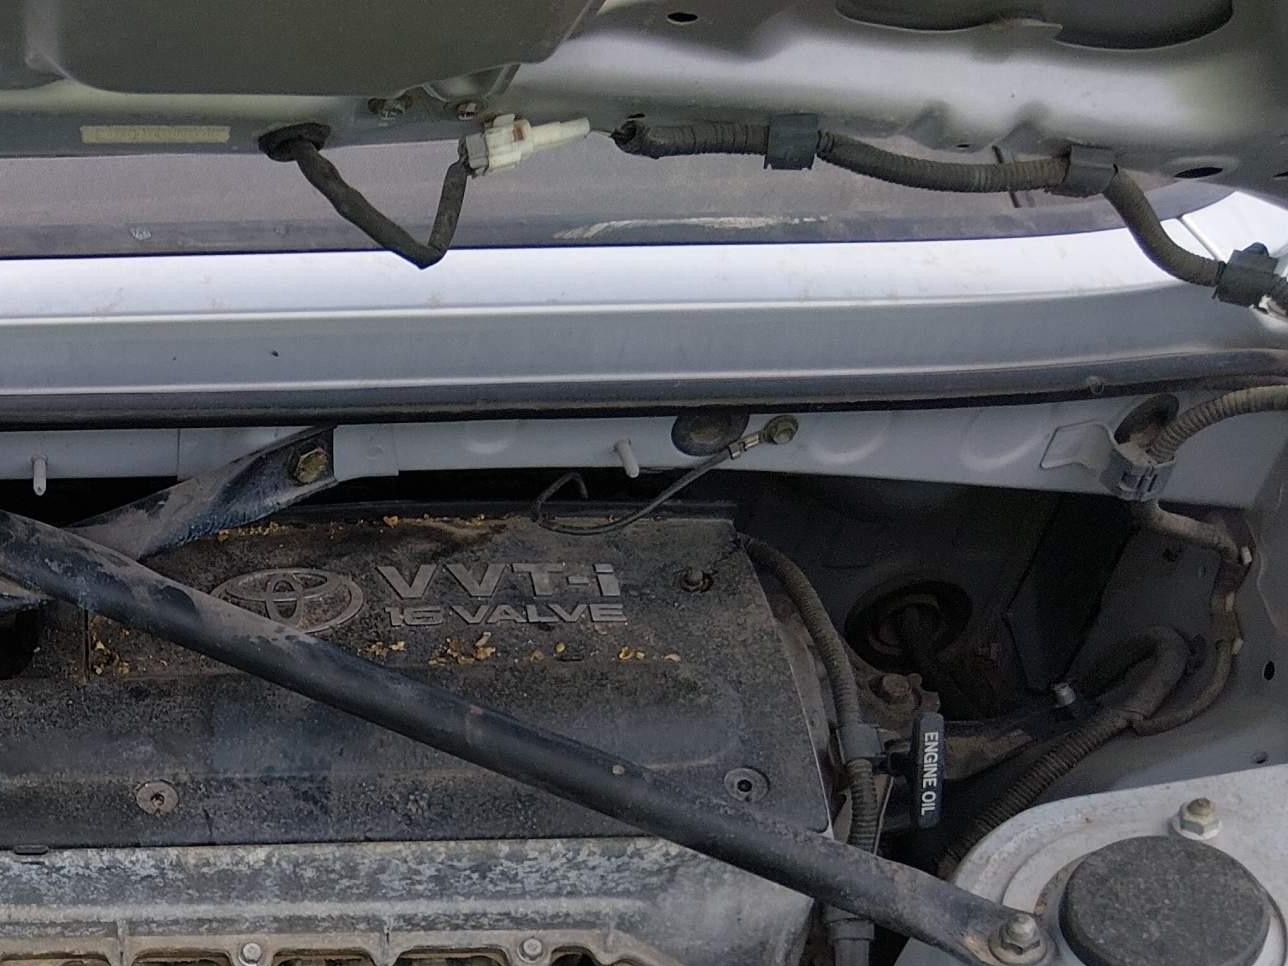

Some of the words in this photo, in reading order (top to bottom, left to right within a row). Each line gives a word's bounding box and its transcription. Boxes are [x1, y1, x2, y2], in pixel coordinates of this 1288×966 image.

[375, 563, 621, 599] VVT-i
[384, 606, 444, 627] 16
[450, 603, 628, 625] VALVE
[922, 731, 939, 789] ENGINE
[920, 790, 937, 816] OIL
